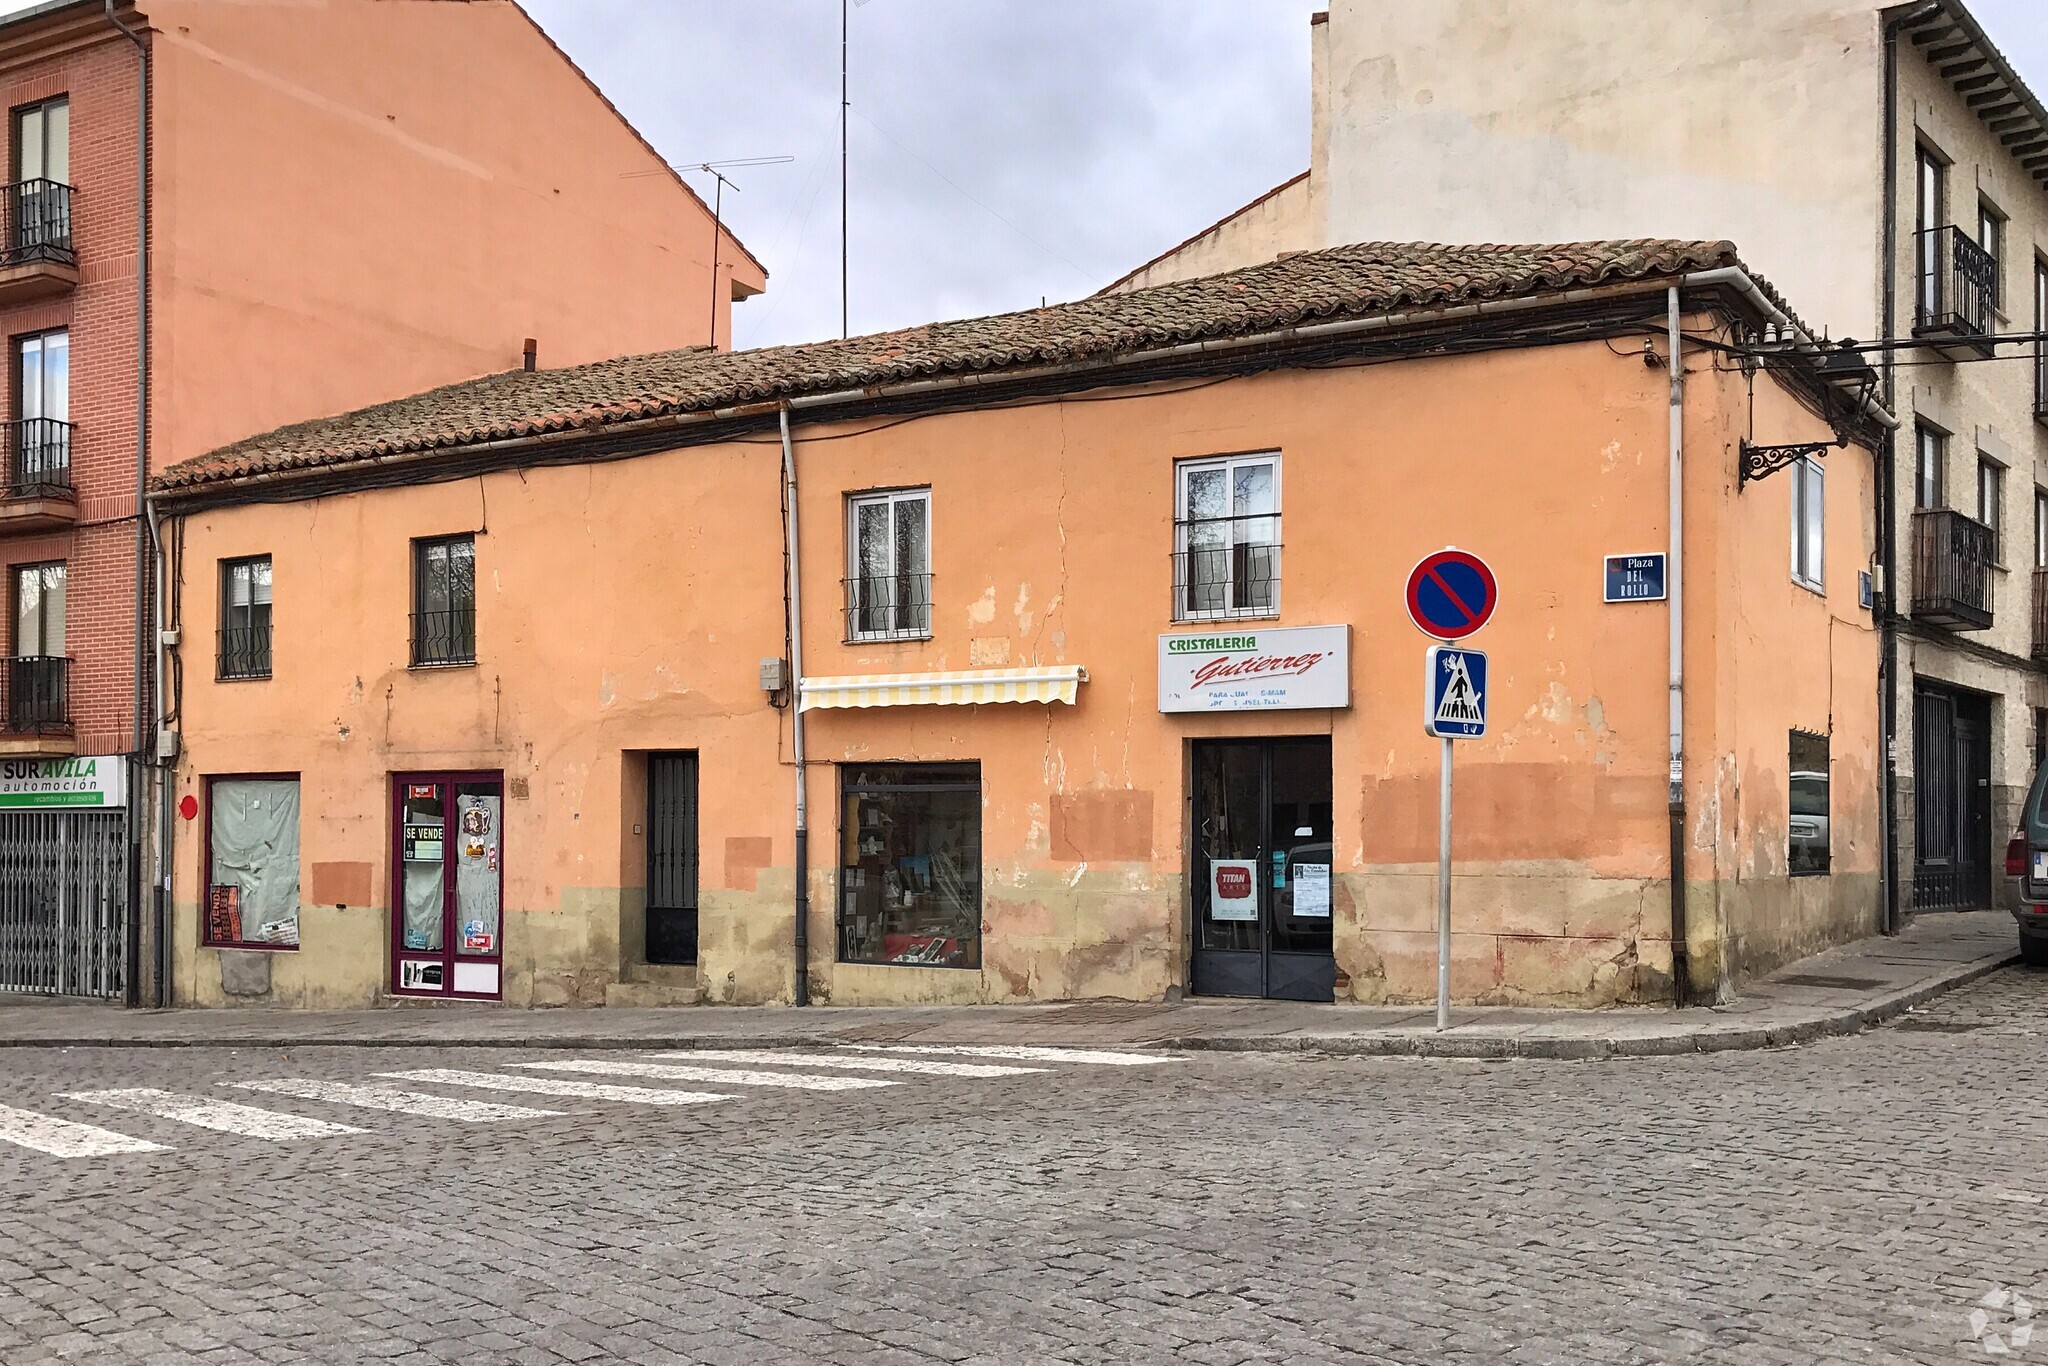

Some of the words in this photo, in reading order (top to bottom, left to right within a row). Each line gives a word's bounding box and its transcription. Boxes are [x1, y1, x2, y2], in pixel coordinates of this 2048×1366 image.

[1627, 558, 1654, 568] Plaza
[1626, 570, 1643, 582] DEL
[1620, 584, 1649, 596] ROLLO
[1168, 636, 1256, 652] CRISTALERIA
[3, 778, 97, 792] automoción
[33, 794, 62, 803] recambios
[406, 827, 416, 838] SE
[418, 827, 443, 839] VENDE
[1222, 873, 1246, 883] TITAN
[213, 926, 223, 940] SE
